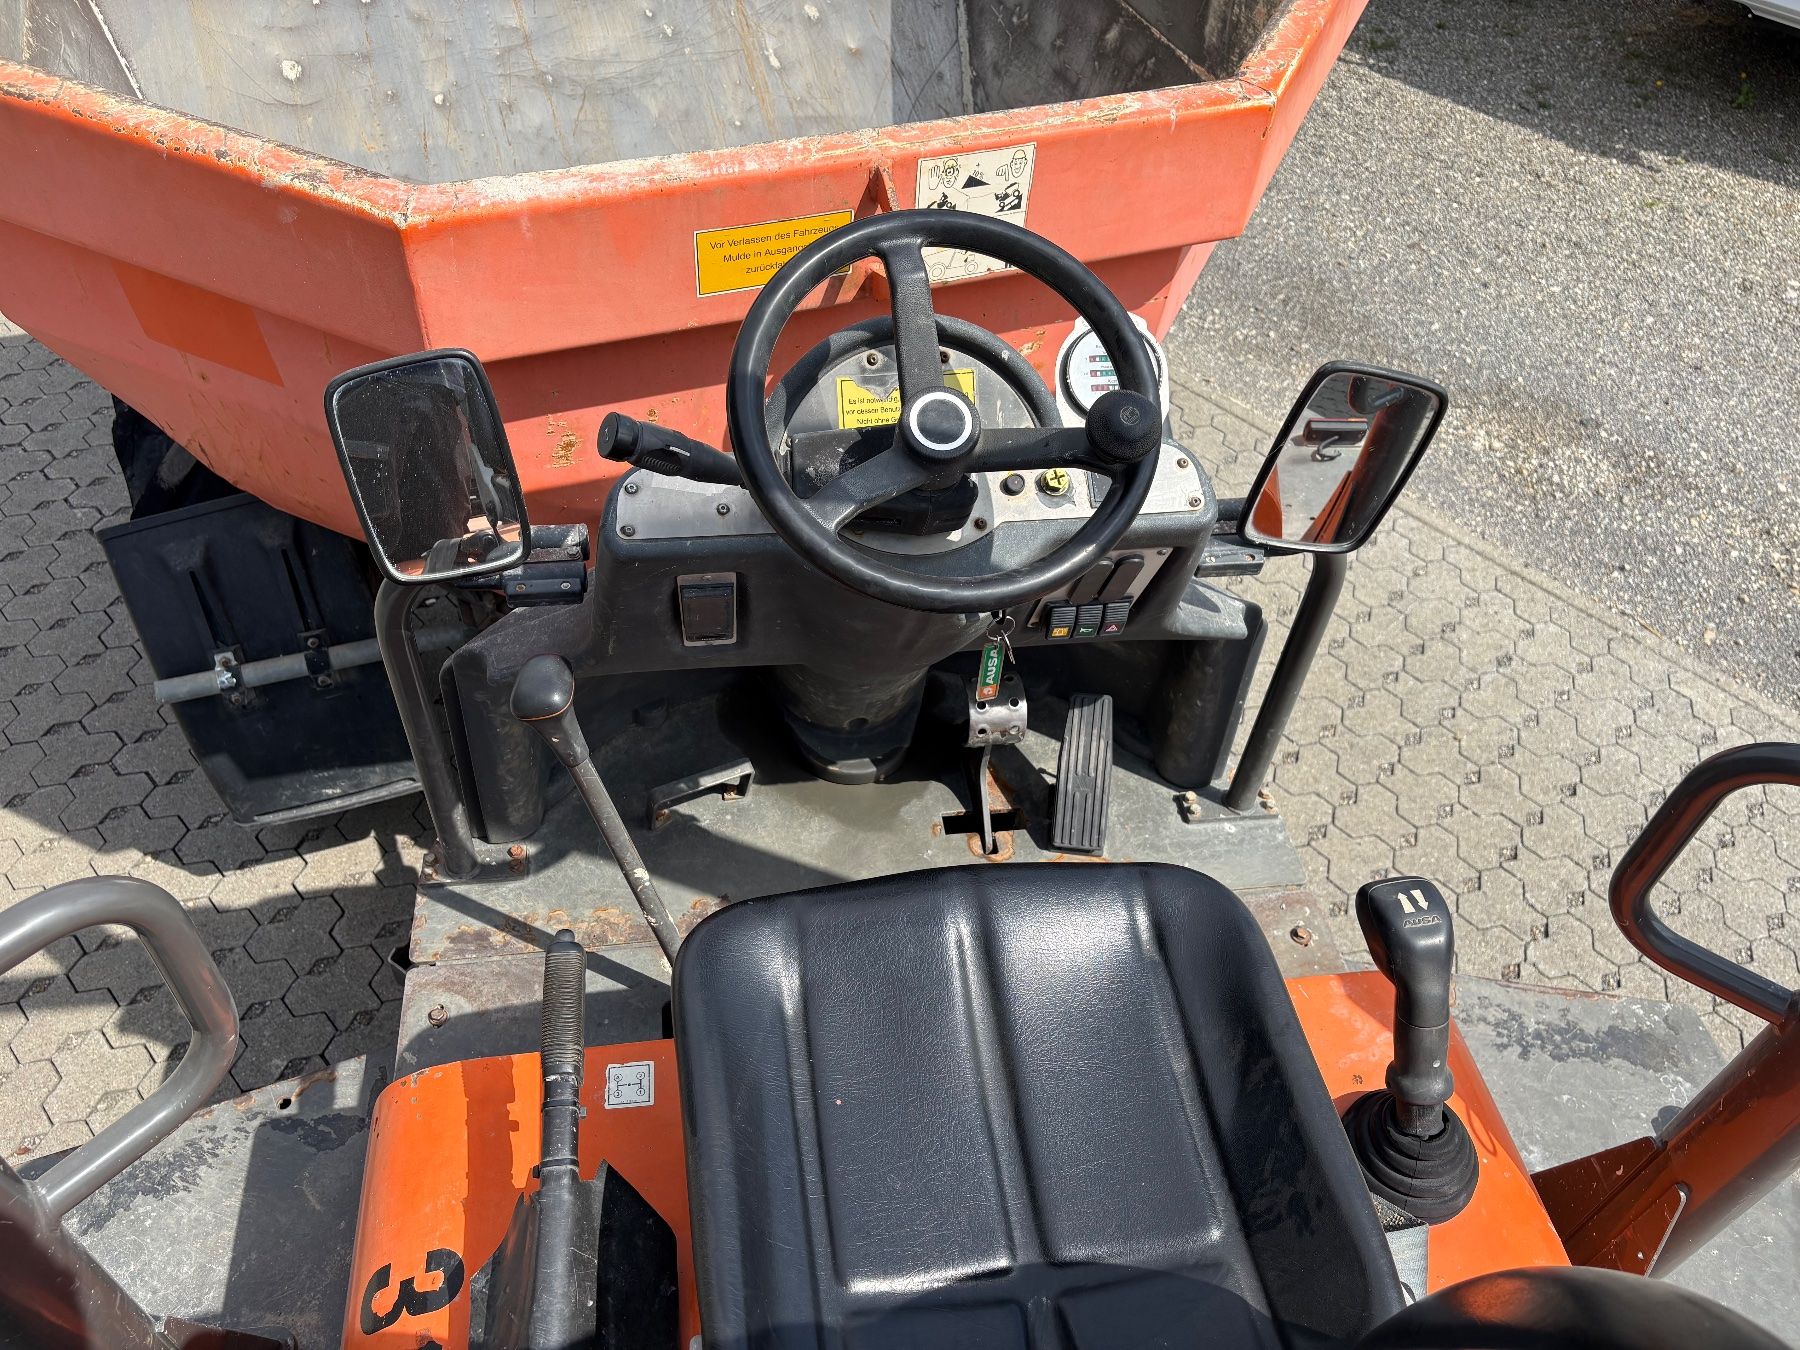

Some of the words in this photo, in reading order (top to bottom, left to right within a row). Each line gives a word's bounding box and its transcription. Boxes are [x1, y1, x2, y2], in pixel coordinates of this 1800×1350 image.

[710, 241, 726, 251] Vor
[727, 235, 772, 248] Verlassen
[775, 231, 791, 241] des
[723, 252, 751, 263] Mulde
[753, 250, 762, 258] in
[985, 649, 998, 685] AUSA
[1402, 914, 1442, 929] AUSA
[360, 1248, 464, 1350] 3
